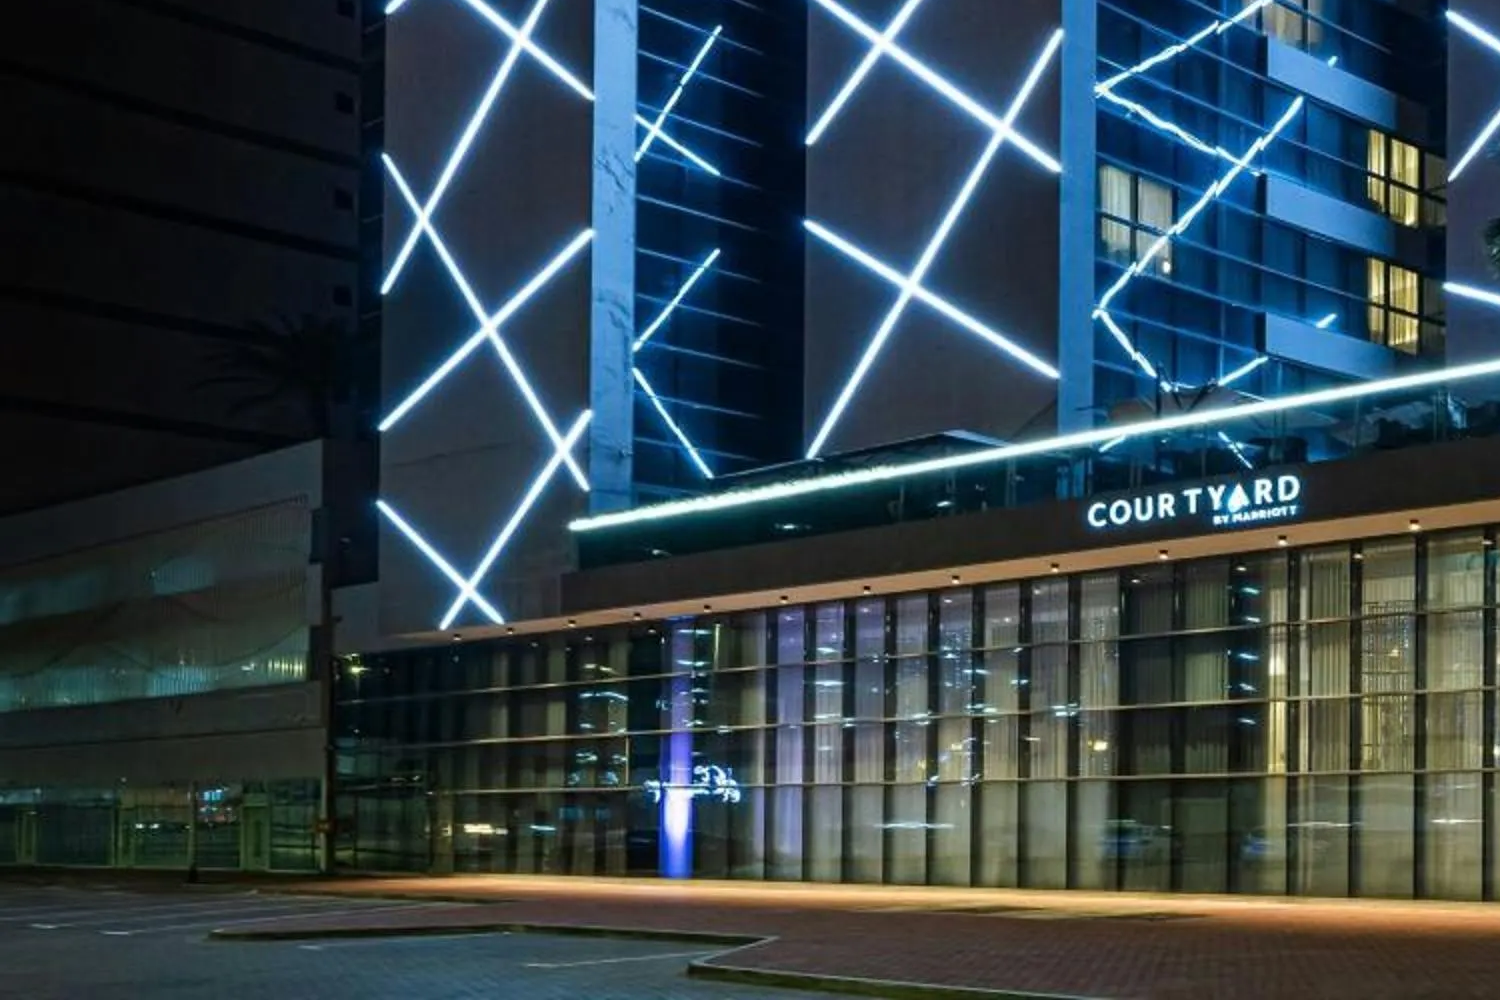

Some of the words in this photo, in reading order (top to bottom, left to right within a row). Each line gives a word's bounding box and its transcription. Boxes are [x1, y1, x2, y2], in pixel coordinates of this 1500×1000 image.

[1087, 475, 1301, 528] COURTYARD
[1212, 514, 1230, 526] BY
[1231, 504, 1298, 523] MARRIOTT
